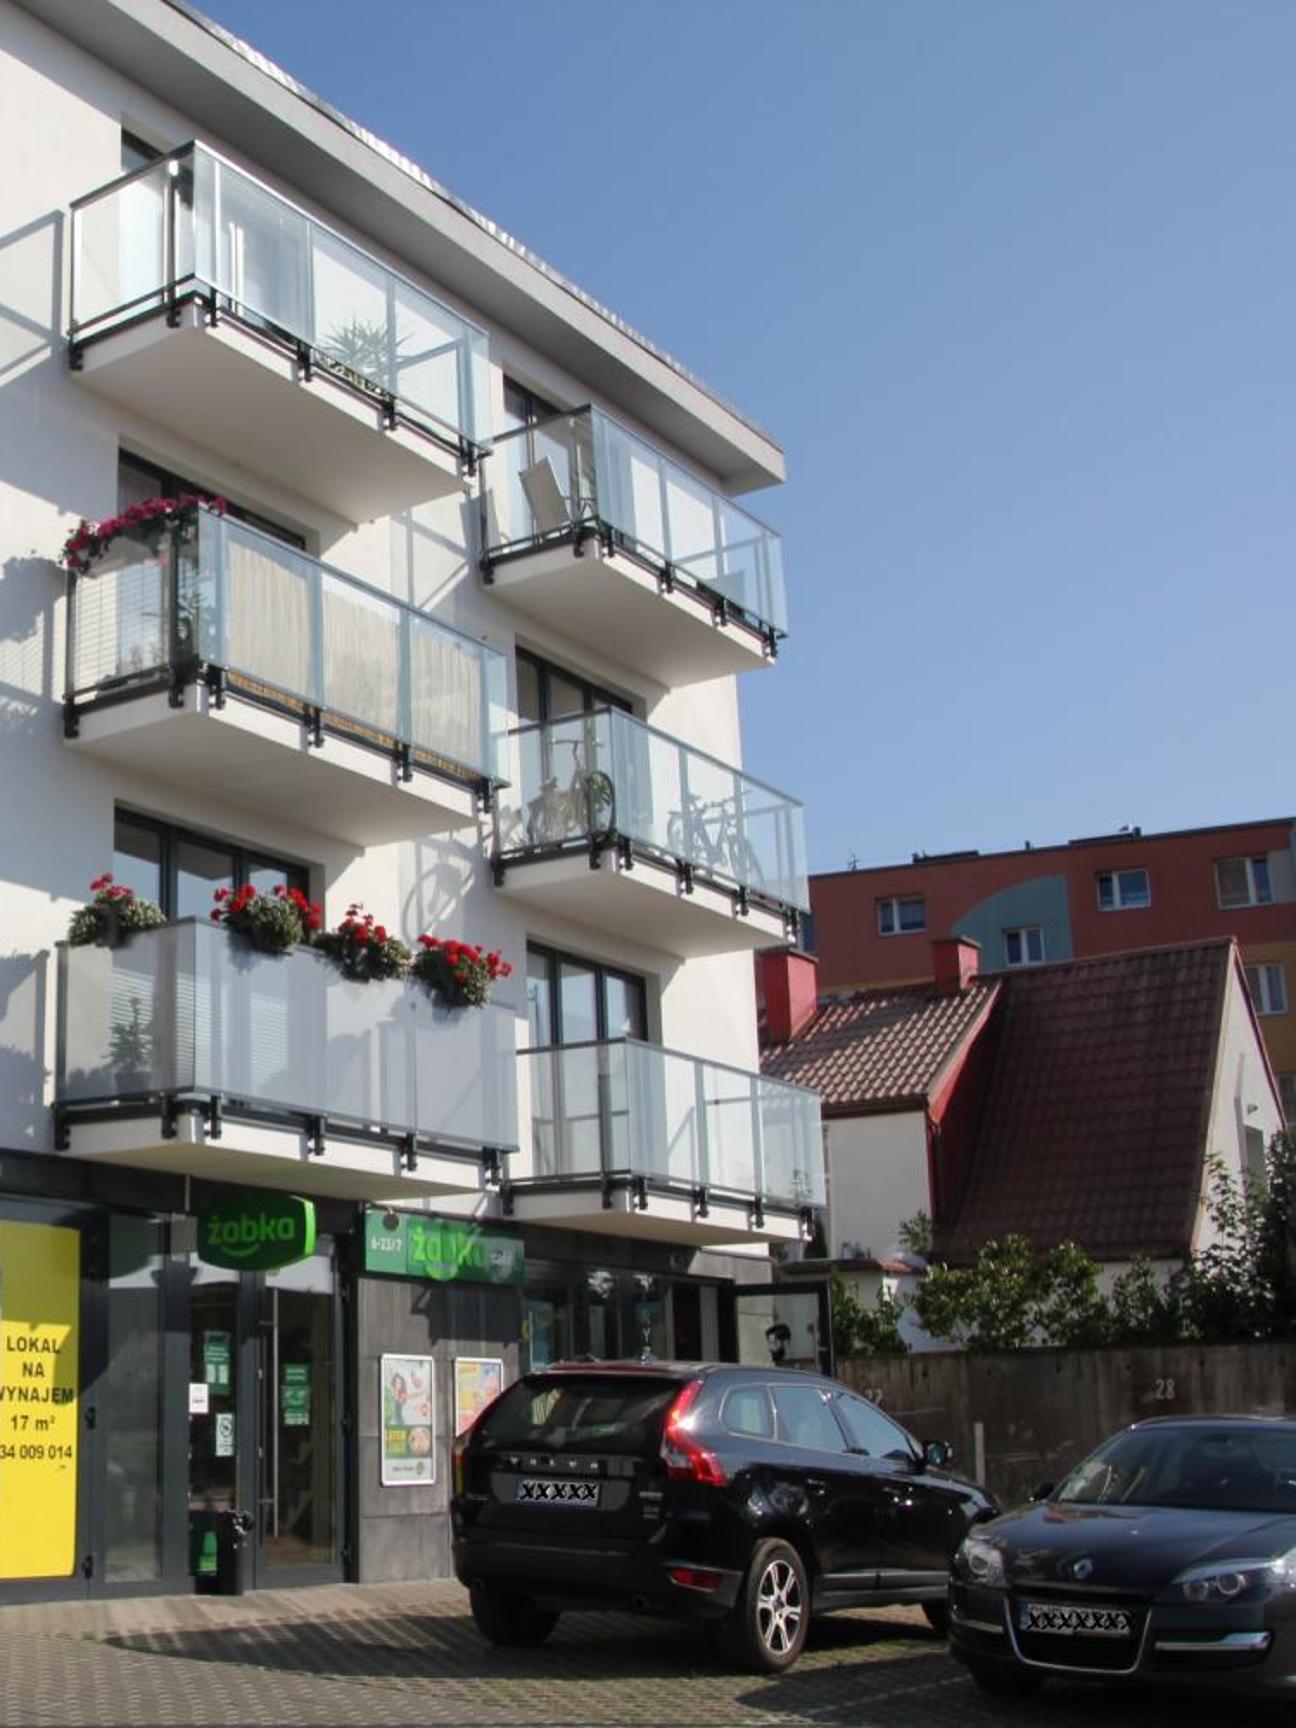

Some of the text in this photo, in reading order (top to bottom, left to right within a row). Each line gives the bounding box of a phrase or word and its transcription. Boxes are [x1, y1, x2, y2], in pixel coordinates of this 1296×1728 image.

[207, 1212, 295, 1244] żabka
[6, 1335, 61, 1354] LOKAL
[22, 1361, 45, 1378] NA
[1154, 1379, 1175, 1399] 28
[10, 1415, 29, 1431] 17
[19, 1444, 44, 1459] 009
[48, 1444, 73, 1460] 014
